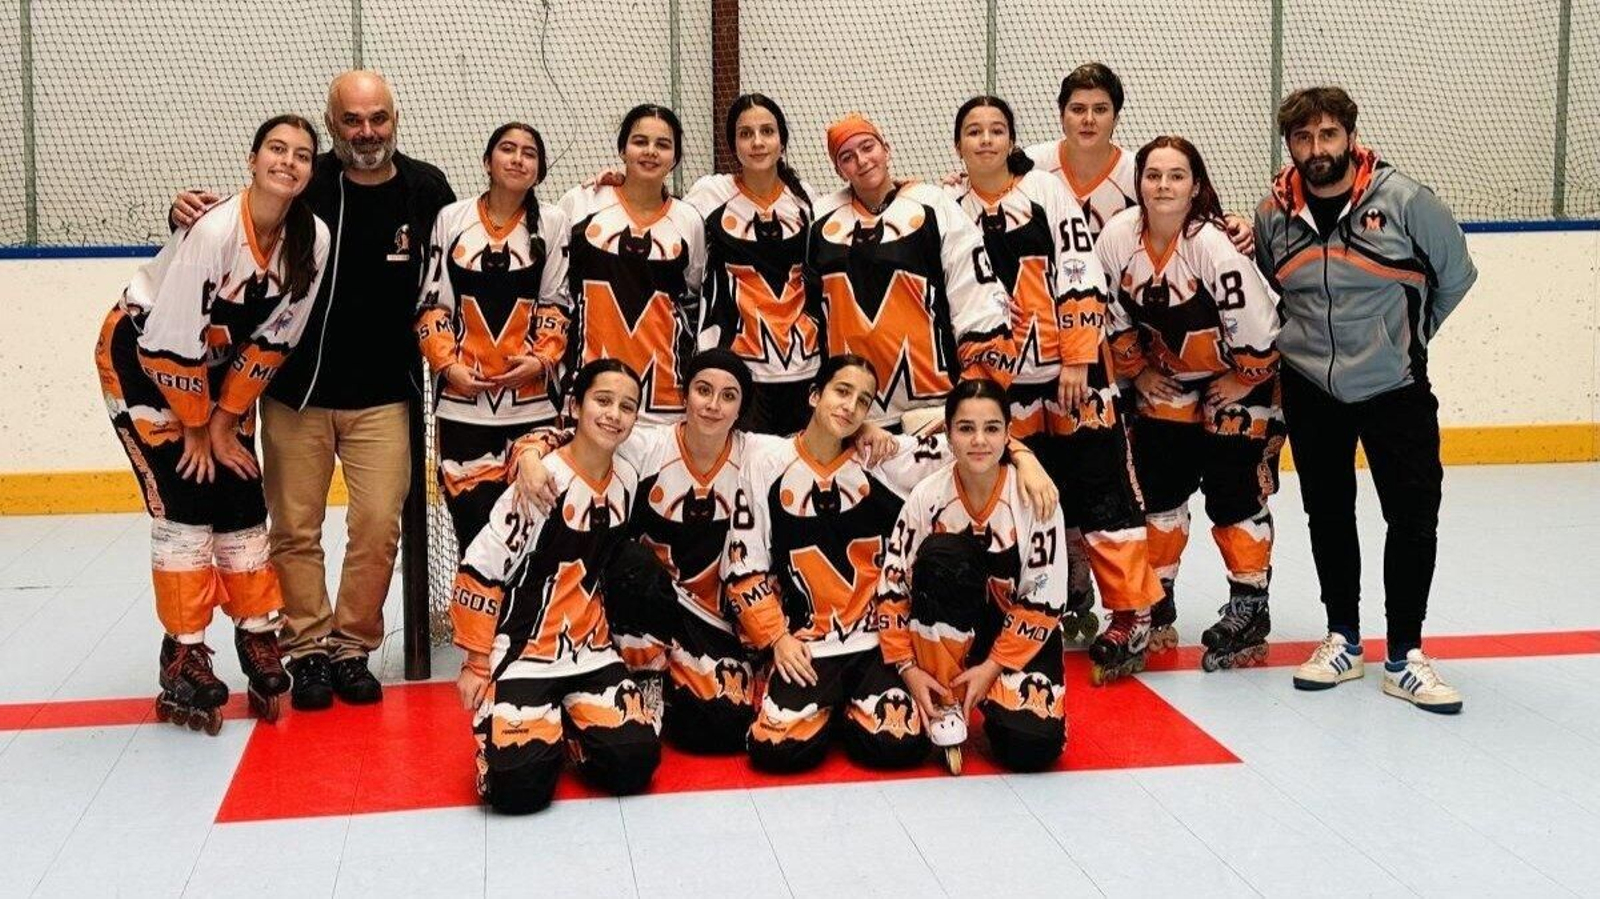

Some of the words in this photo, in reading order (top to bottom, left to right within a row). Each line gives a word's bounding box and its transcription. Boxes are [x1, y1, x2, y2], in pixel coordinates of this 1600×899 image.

[581, 279, 688, 414] M
[821, 268, 953, 402] M
[1027, 526, 1057, 569] 31
